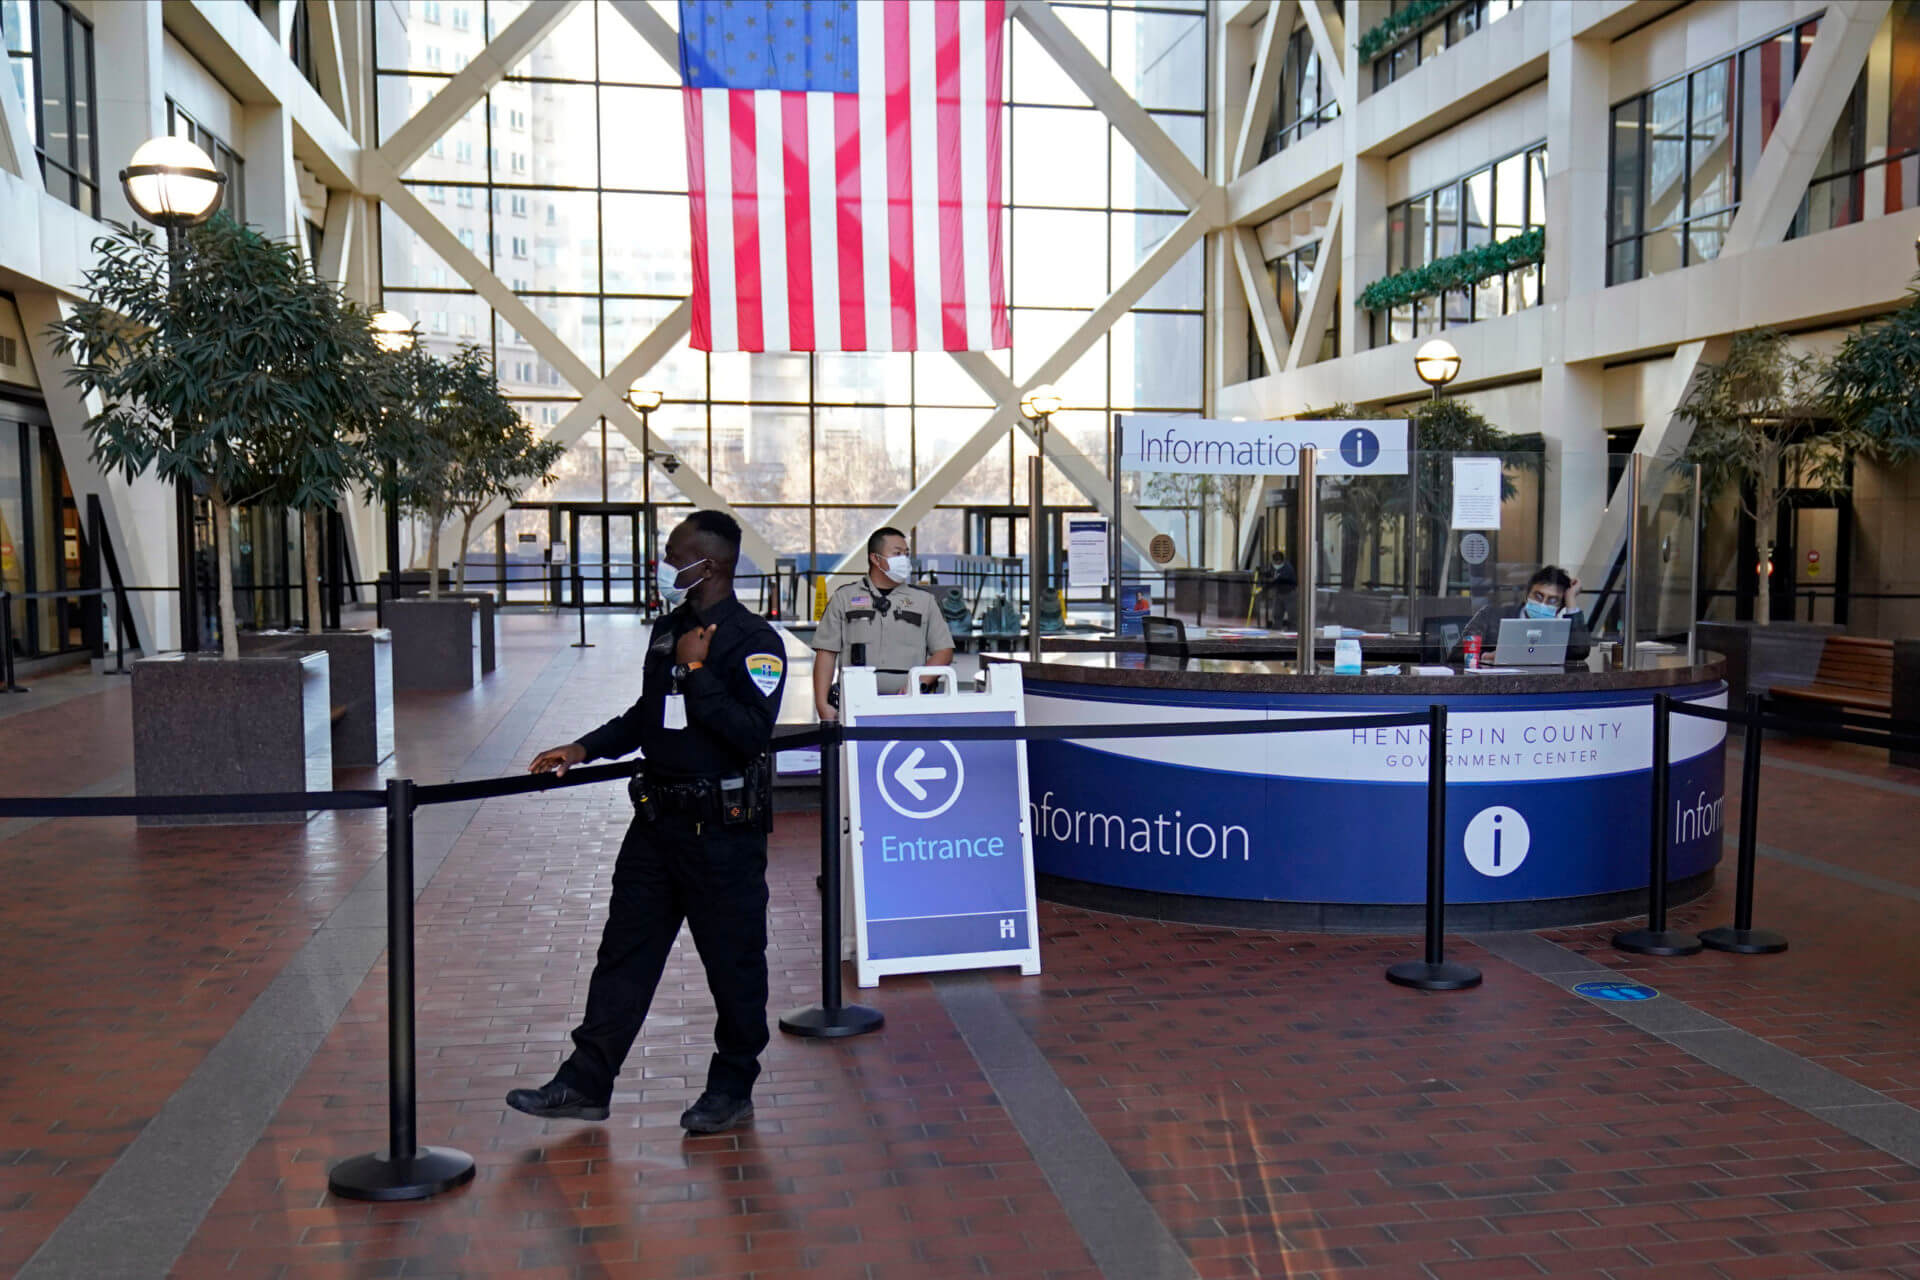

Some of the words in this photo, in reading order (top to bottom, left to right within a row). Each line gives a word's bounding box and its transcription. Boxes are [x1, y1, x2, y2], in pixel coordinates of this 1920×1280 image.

[1523, 722, 1622, 743] COUNTY
[1386, 753, 1522, 767] GOVRNMENT
[1533, 749, 1598, 765] CENTER
[1029, 791, 1250, 861] nformation
[881, 835, 1004, 863] Entrance
